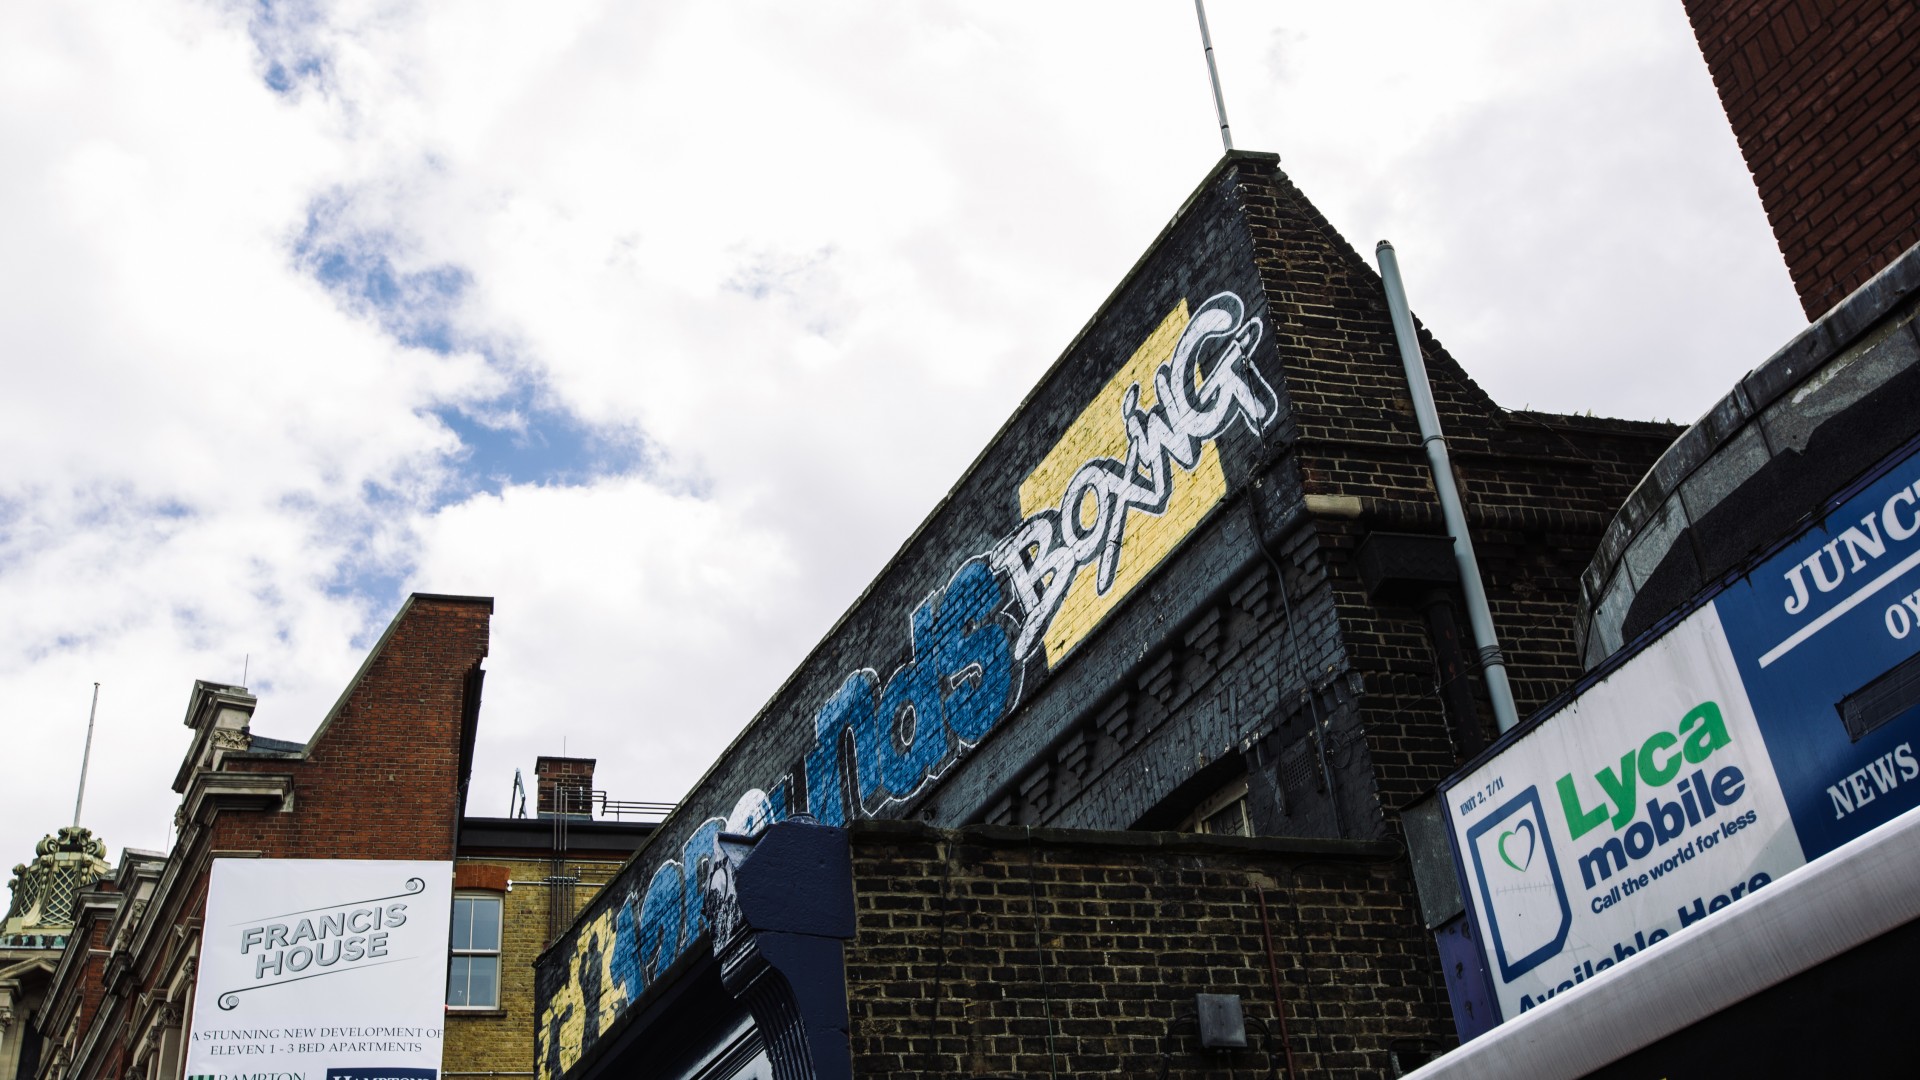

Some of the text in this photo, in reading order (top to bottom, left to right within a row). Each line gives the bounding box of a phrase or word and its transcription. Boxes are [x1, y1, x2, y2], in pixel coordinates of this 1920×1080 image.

[1783, 479, 1920, 615] JUNC
[1555, 700, 1732, 842] Lyca
[1826, 741, 1919, 820] NEWS
[1460, 795, 1477, 816] UNIT
[1577, 765, 1746, 891] mobile
[1591, 809, 1757, 914] Call the world for less
[240, 903, 408, 955] FRANCIS
[255, 931, 389, 979] HOUSE
[192, 1027, 444, 1041] A STUNNING NEW DEVELOPMENT OF
[210, 1044, 266, 1056] ELEVEN
[287, 1043, 295, 1054] 3
[298, 1042, 325, 1053] BED
[328, 1041, 422, 1053] APARTMENTS
